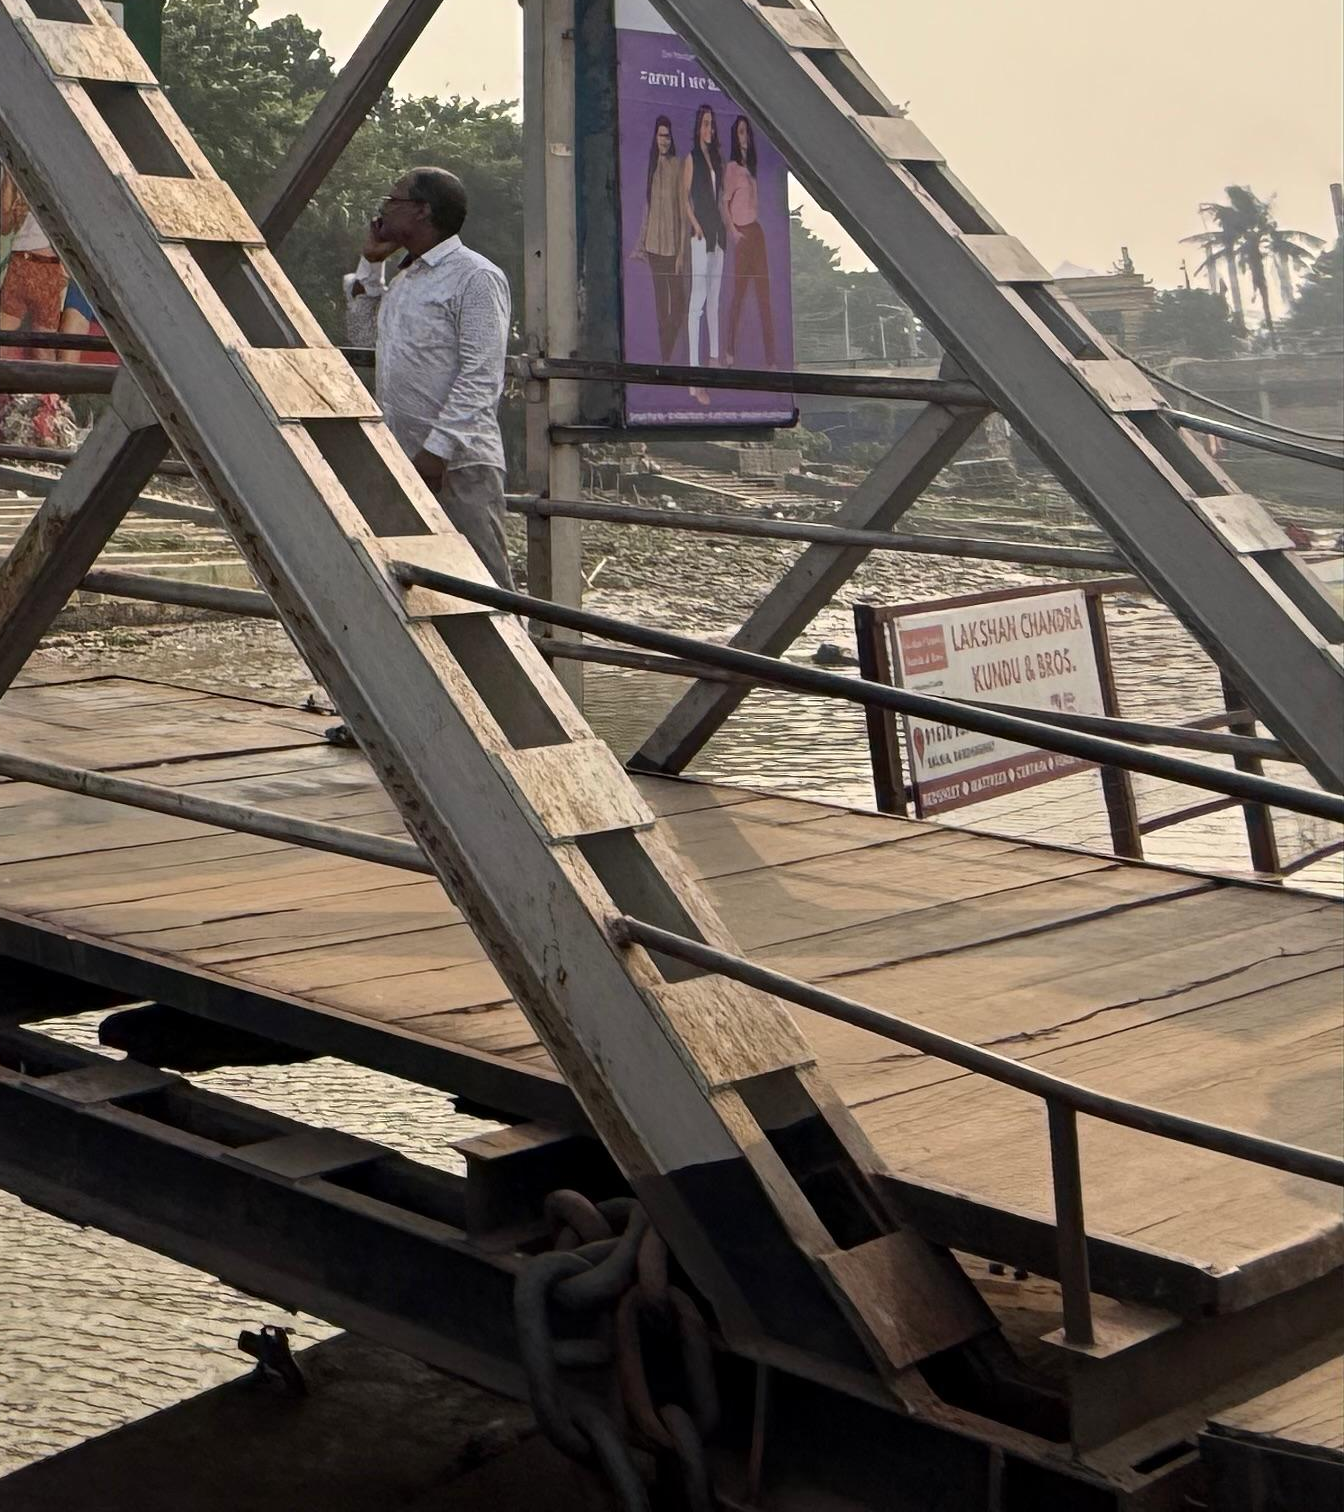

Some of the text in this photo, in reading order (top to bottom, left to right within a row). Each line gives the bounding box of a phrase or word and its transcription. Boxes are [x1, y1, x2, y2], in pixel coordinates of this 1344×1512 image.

[951, 603, 1083, 653] LAKSHAN CHANDRA
[971, 656, 1022, 693] KUNDU
[1024, 654, 1036, 681] &
[1037, 647, 1077, 678] BROS.
